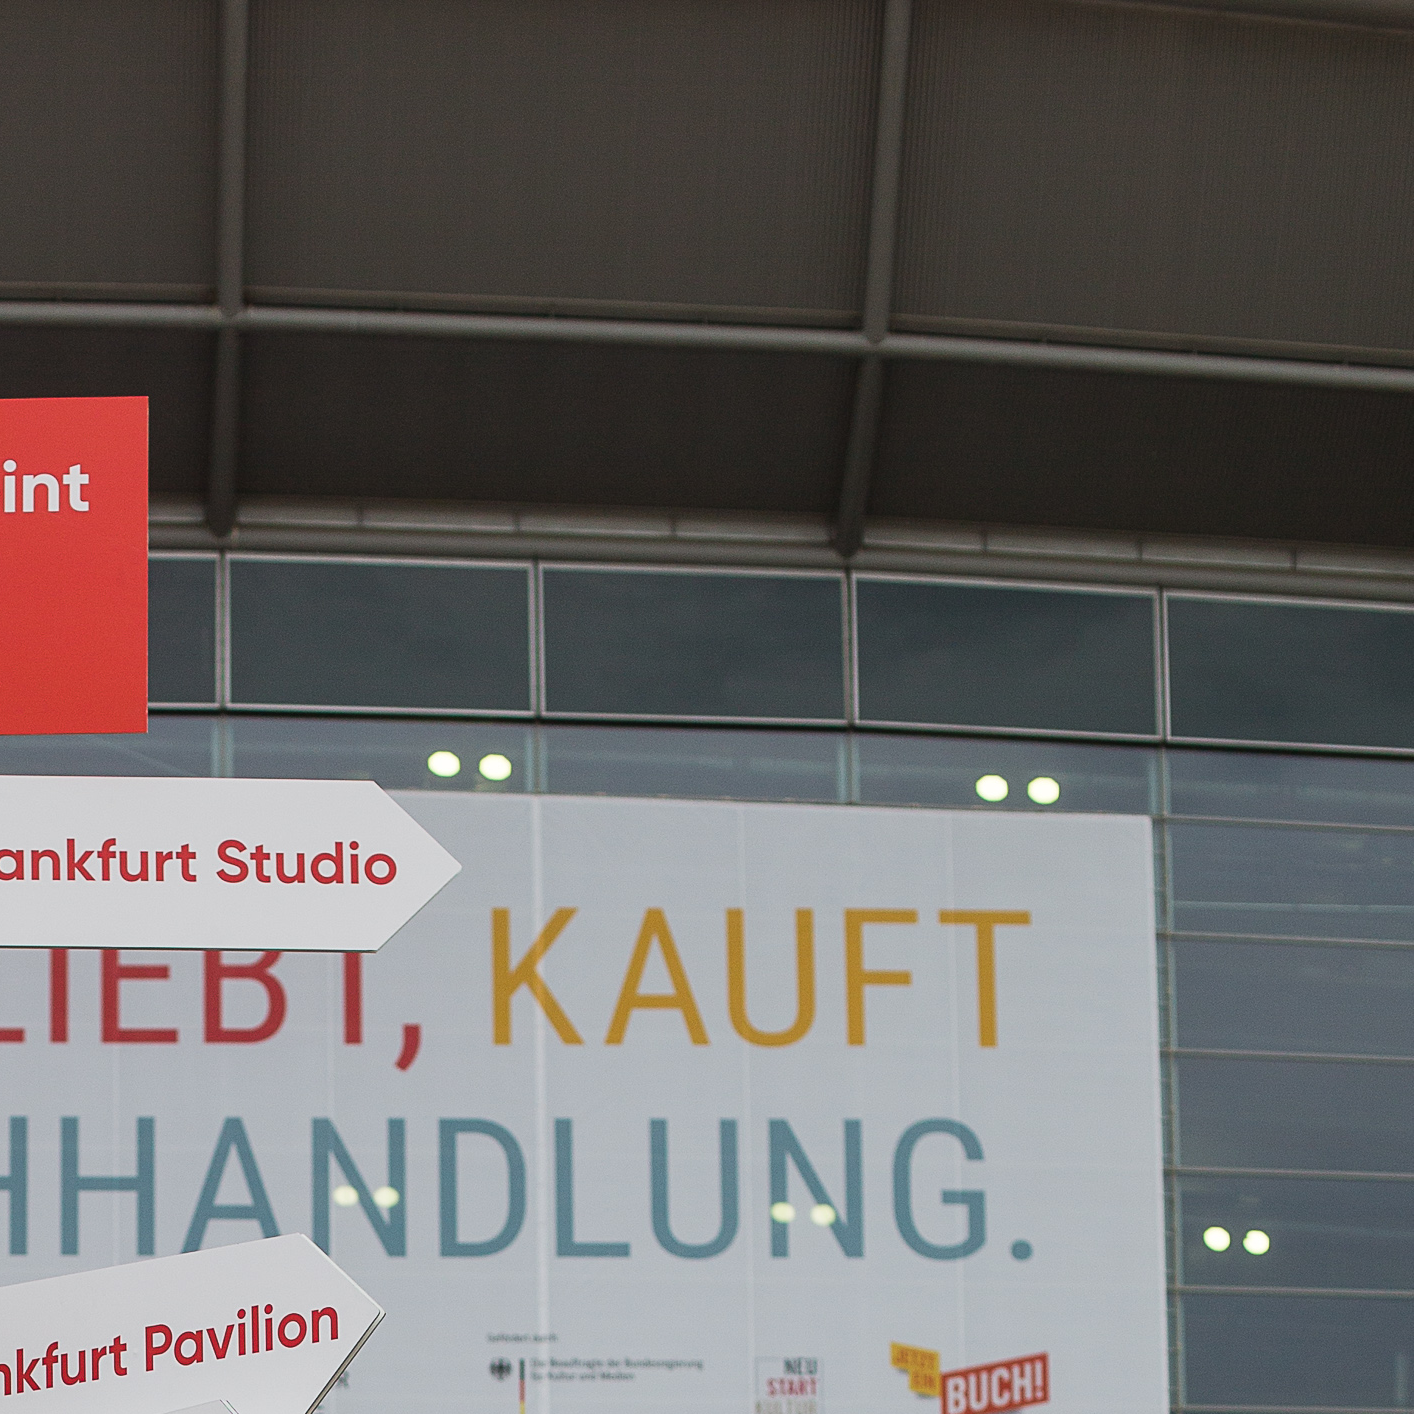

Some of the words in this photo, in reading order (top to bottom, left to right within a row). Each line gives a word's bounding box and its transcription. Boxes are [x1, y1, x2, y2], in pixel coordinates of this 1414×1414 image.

[216, 839, 398, 886] Studio
[490, 906, 1032, 1048] KAUFT
[144, 1303, 339, 1373] Pavilion
[766, 1377, 819, 1397] START
[783, 1356, 819, 1376] NEU
